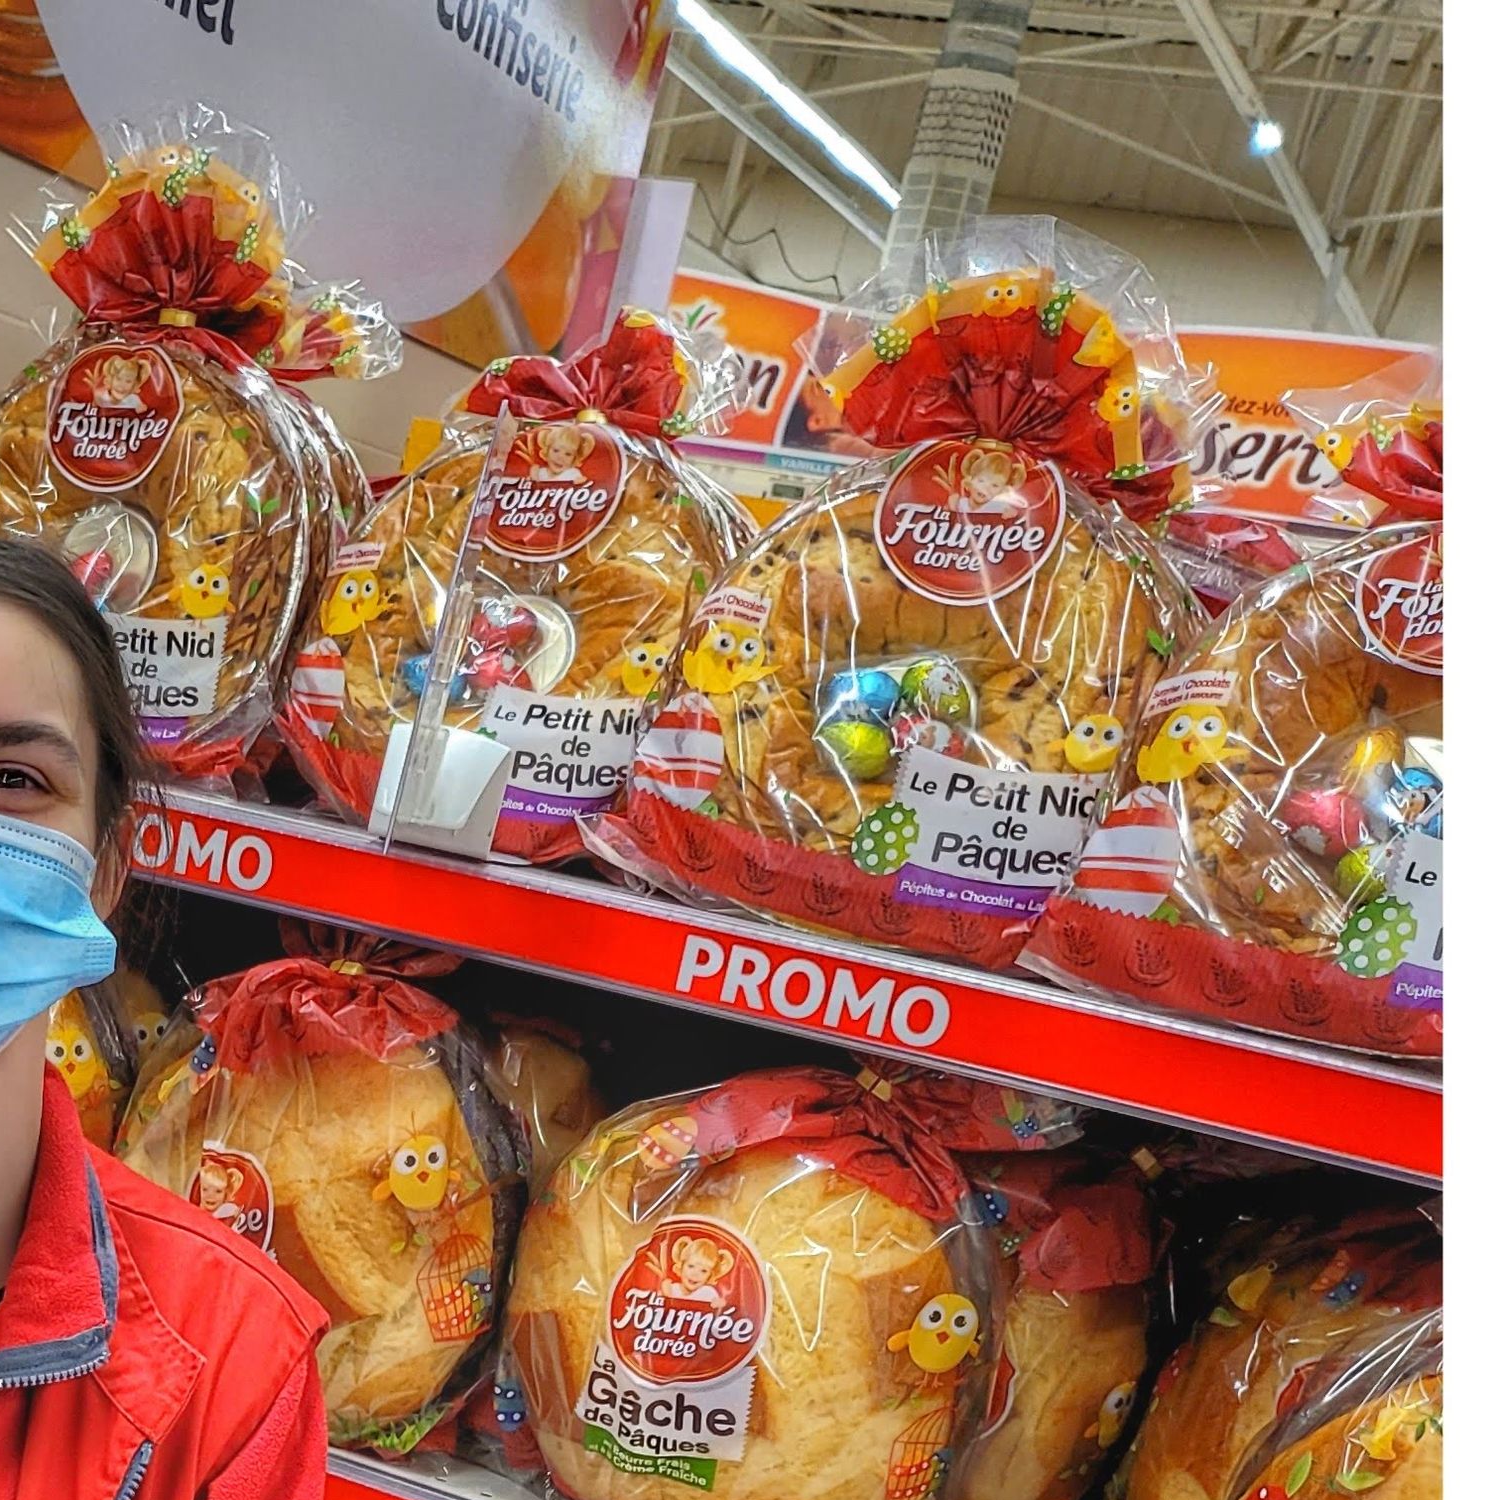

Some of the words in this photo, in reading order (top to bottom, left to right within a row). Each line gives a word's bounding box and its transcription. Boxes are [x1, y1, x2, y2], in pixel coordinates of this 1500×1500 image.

[51, 401, 172, 458] Fournée
[71, 435, 129, 462] dorée
[497, 504, 558, 532] dorée
[885, 504, 1046, 560] Fournée
[913, 543, 982, 572] dorée
[110, 629, 159, 659] etit
[165, 630, 215, 660] Nid
[130, 657, 159, 680] de
[127, 680, 200, 710] ques
[493, 703, 518, 725] Le
[522, 702, 595, 734] Petit
[560, 735, 592, 759] de
[510, 747, 629, 794] Pâques
[909, 770, 939, 798] Le
[944, 771, 1031, 814] Petit
[991, 815, 1029, 842] de
[132, 812, 275, 892] OMO
[929, 830, 1079, 880] Pâques
[1404, 860, 1439, 888] Le
[899, 878, 946, 900] Pépites
[960, 887, 1015, 910] Chocolat
[674, 934, 953, 1049] PROMO
[613, 1287, 755, 1350] Fournée
[633, 1329, 697, 1358] dorée
[593, 1345, 617, 1375] La
[587, 1369, 737, 1437] Gâche
[583, 1406, 614, 1427] de
[618, 1423, 711, 1454] Pâques
